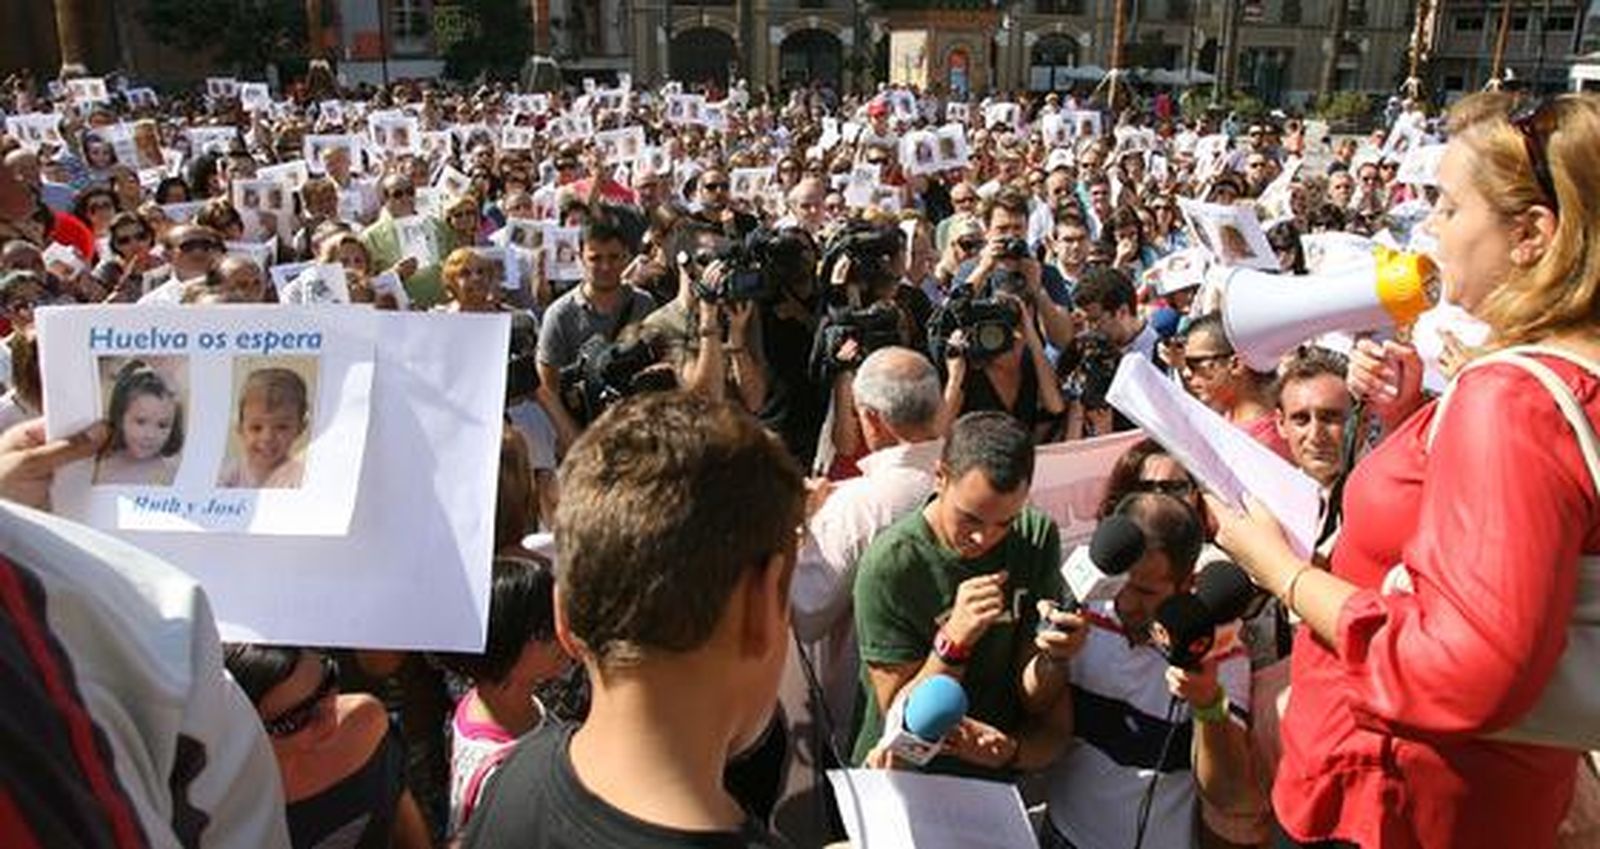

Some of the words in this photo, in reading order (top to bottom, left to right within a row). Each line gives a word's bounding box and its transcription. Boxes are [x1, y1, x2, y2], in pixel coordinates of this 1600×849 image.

[89, 326, 188, 350] Huelva
[198, 331, 227, 350] os
[235, 330, 323, 355] espera
